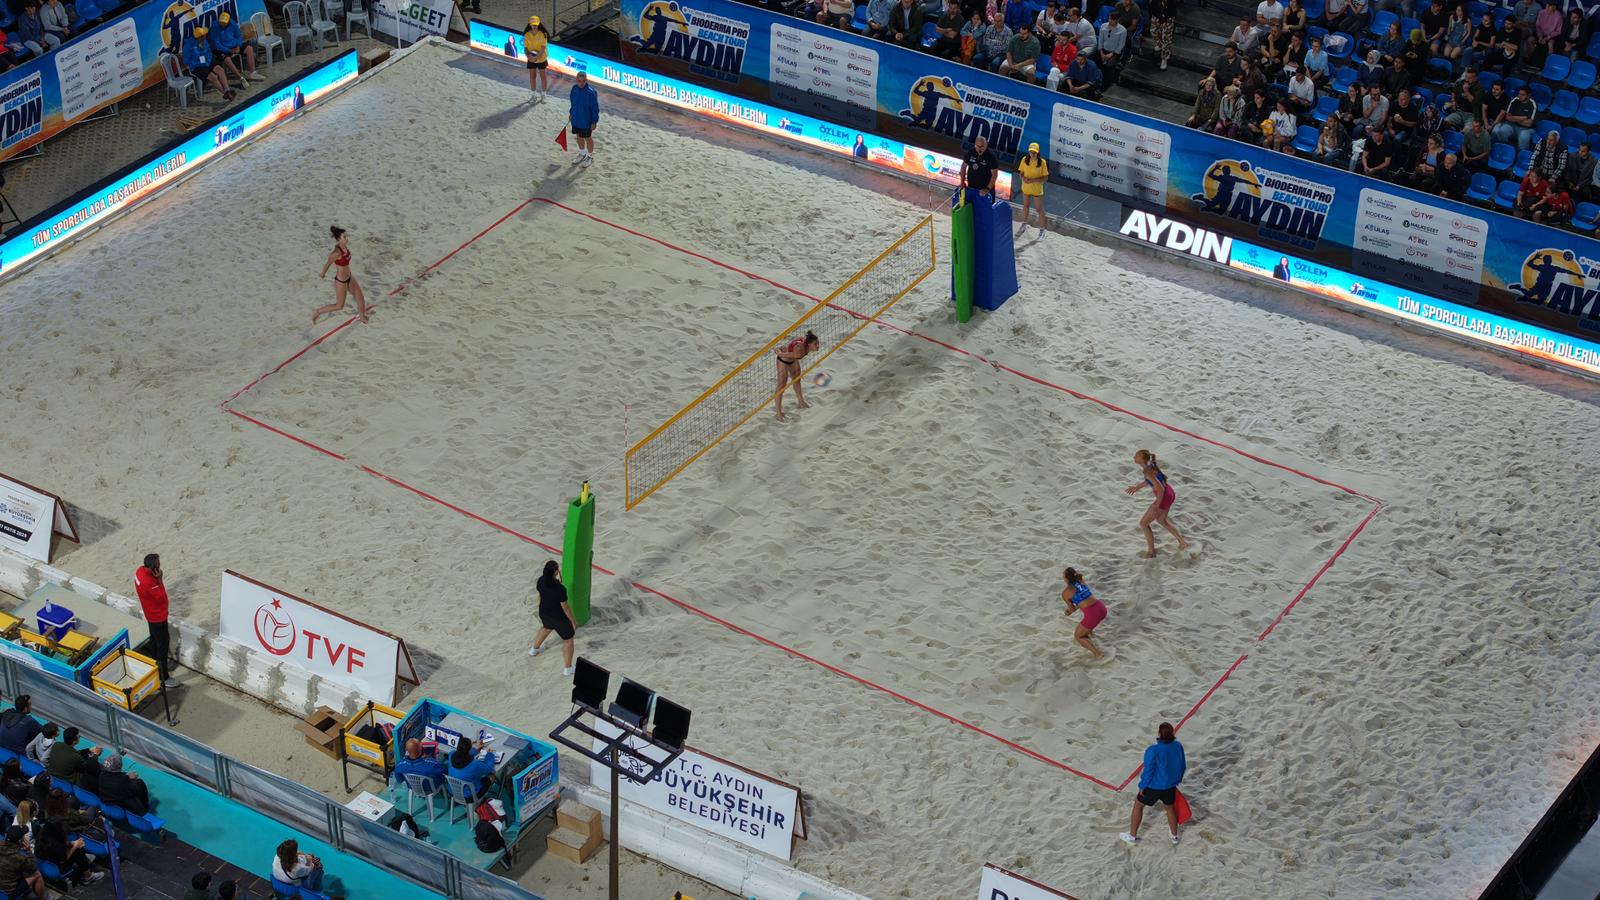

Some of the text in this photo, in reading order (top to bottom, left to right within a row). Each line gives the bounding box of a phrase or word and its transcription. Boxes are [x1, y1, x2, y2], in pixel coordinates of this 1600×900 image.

[690, 16, 733, 35] BIODERMA
[732, 27, 748, 39] PRO
[697, 28, 746, 48] BEACH TOUR
[663, 30, 744, 75] AYDIN
[602, 65, 768, 125] TÜM SPORCULARA BAŞARILAR DİLERİM
[965, 93, 1028, 119] BIODERMA PRO
[222, 124, 245, 144] AYDIN
[819, 125, 849, 139] ÖZLEM
[934, 107, 1023, 155] AYDIN
[972, 106, 1026, 128] BEACH TOUR
[31, 229, 51, 249] TÜM
[52, 198, 106, 238] SPORCULARA
[153, 152, 187, 182] DİLERİM
[1264, 177, 1333, 204] BIODERMA PRO
[1272, 191, 1329, 213] BEACH TOUR
[1119, 209, 1232, 265] AYDIN
[1228, 192, 1326, 242] AYDIN
[1421, 212, 1434, 220] TVF
[1293, 260, 1328, 278] ÖZLEM
[1397, 295, 1420, 315] TÜM
[1422, 304, 1493, 336] SPORCULARA
[1494, 326, 1556, 354] BAŞARILAR
[302, 629, 365, 674] TVF
[653, 768, 785, 830] BÜYÜKŞEHİR
[678, 758, 764, 801] T.C. AYDIN
[668, 791, 766, 840] BELEDİYESİ
